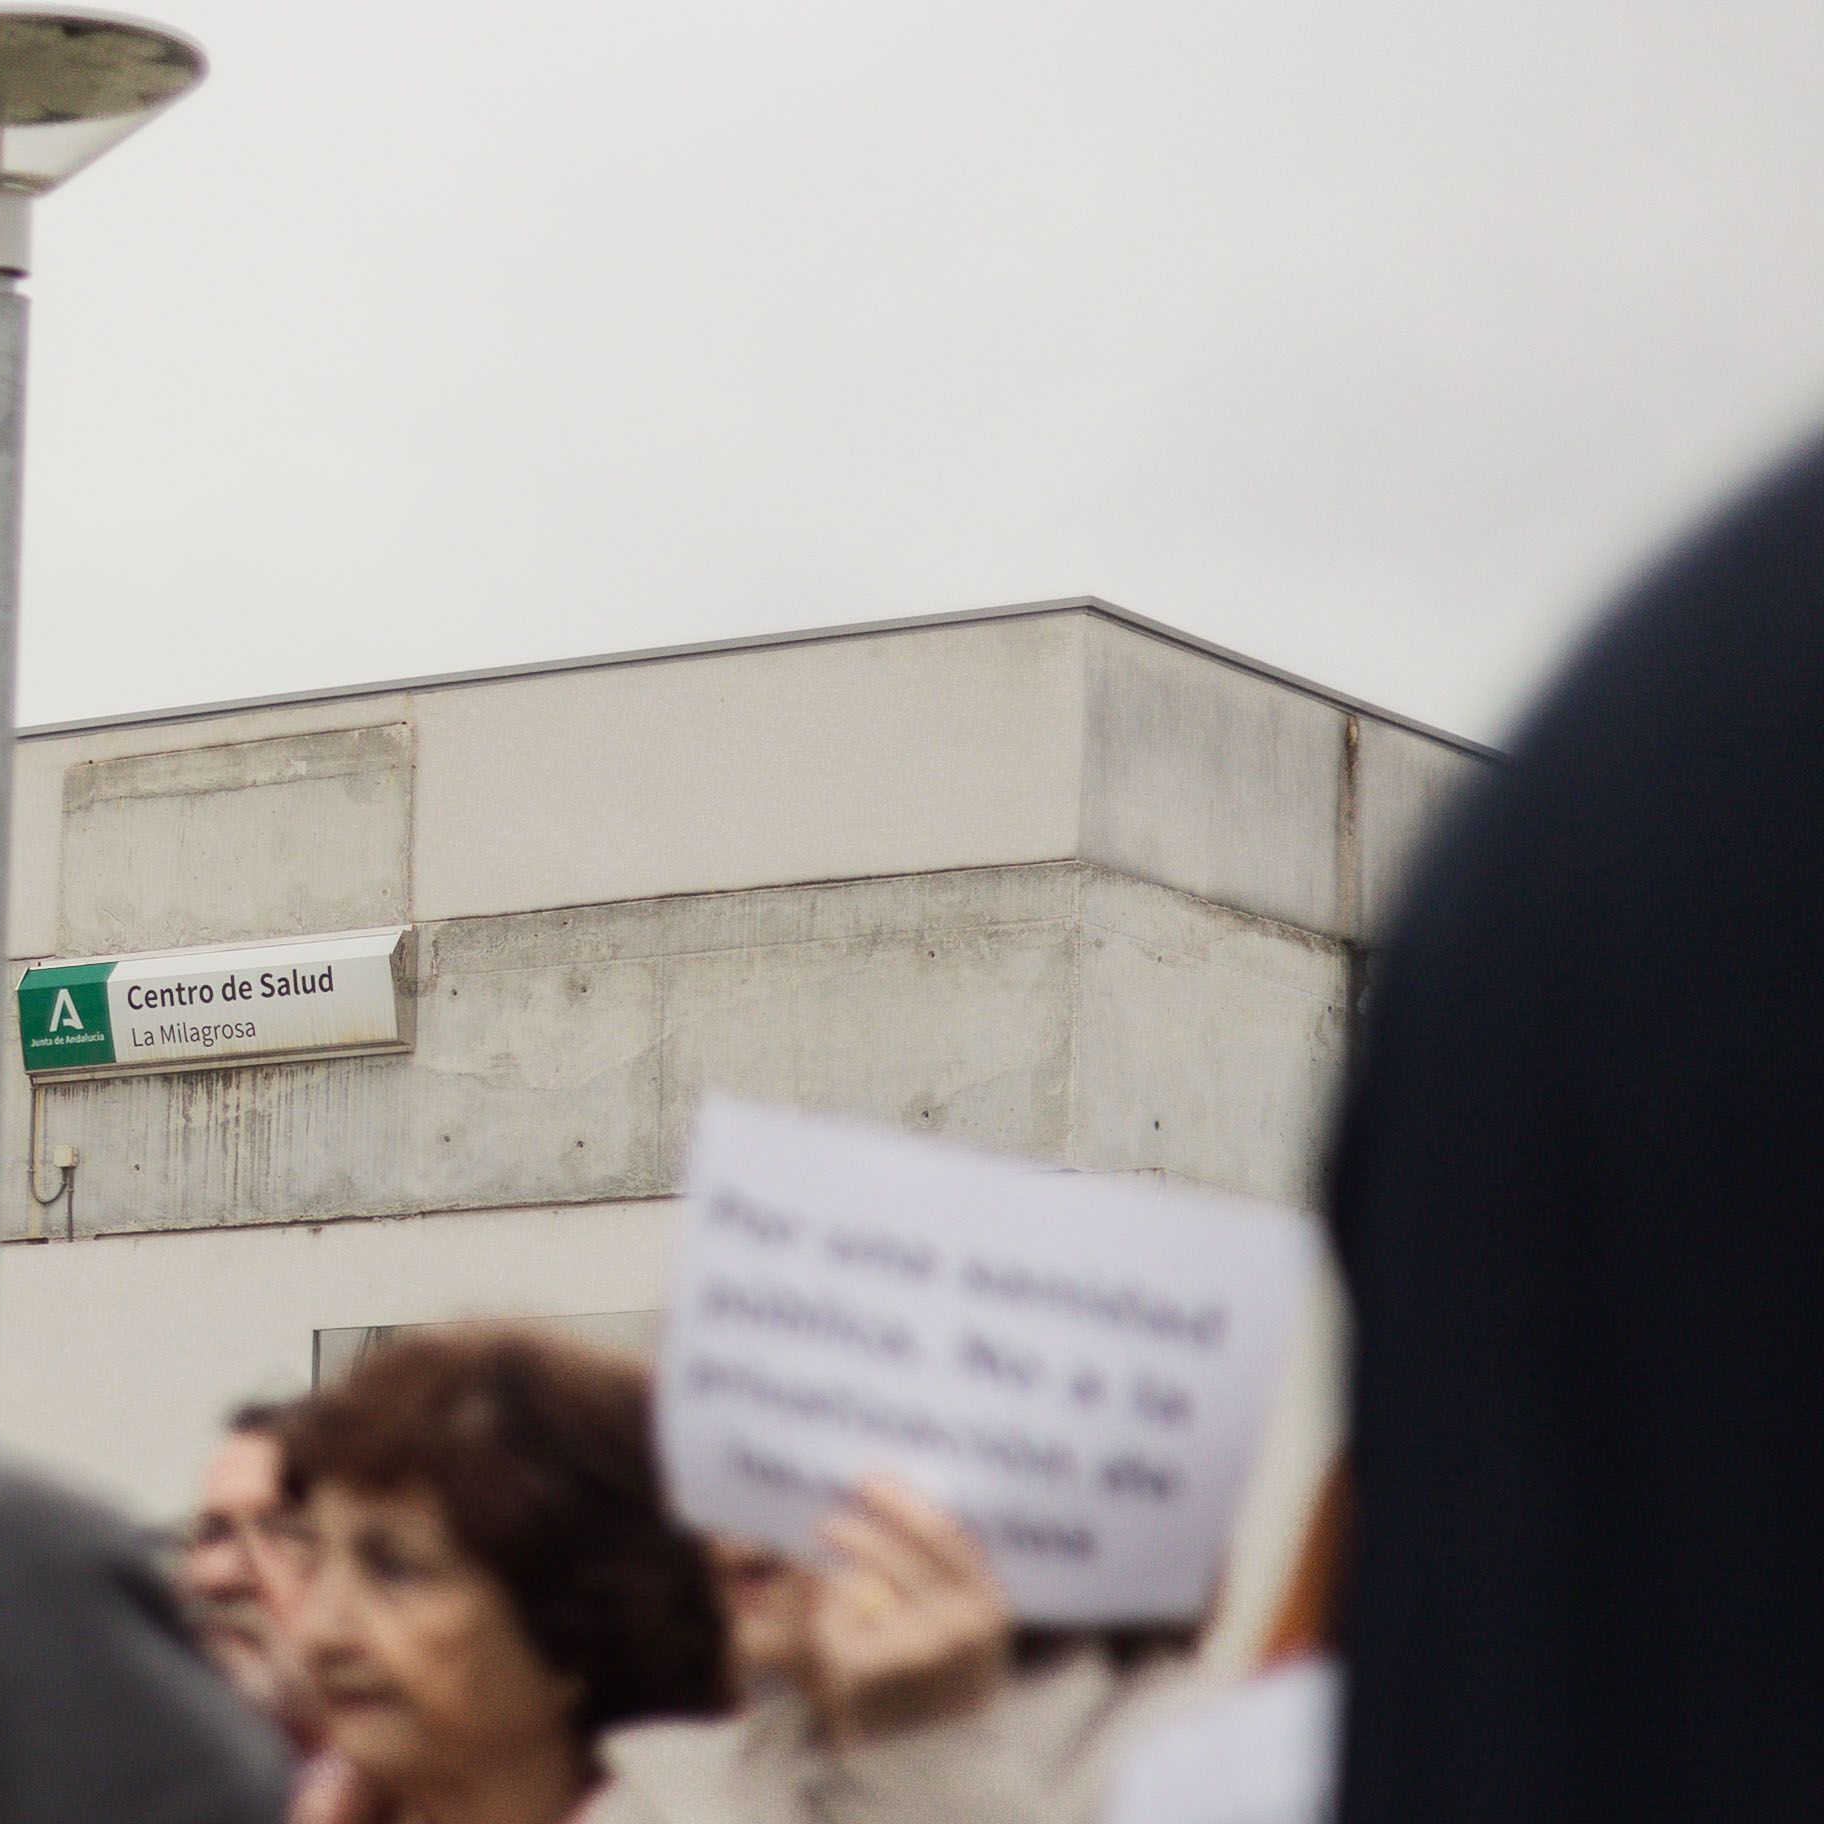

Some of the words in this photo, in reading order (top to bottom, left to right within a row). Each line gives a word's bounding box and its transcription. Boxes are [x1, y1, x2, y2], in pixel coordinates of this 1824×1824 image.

[127, 983, 214, 1010] Centro
[221, 975, 253, 1001] de
[260, 965, 334, 998] Salud
[30, 1038, 53, 1048] Junta
[53, 1035, 65, 1045] de
[131, 1027, 154, 1048] La
[160, 1021, 257, 1048] Milagrosa
